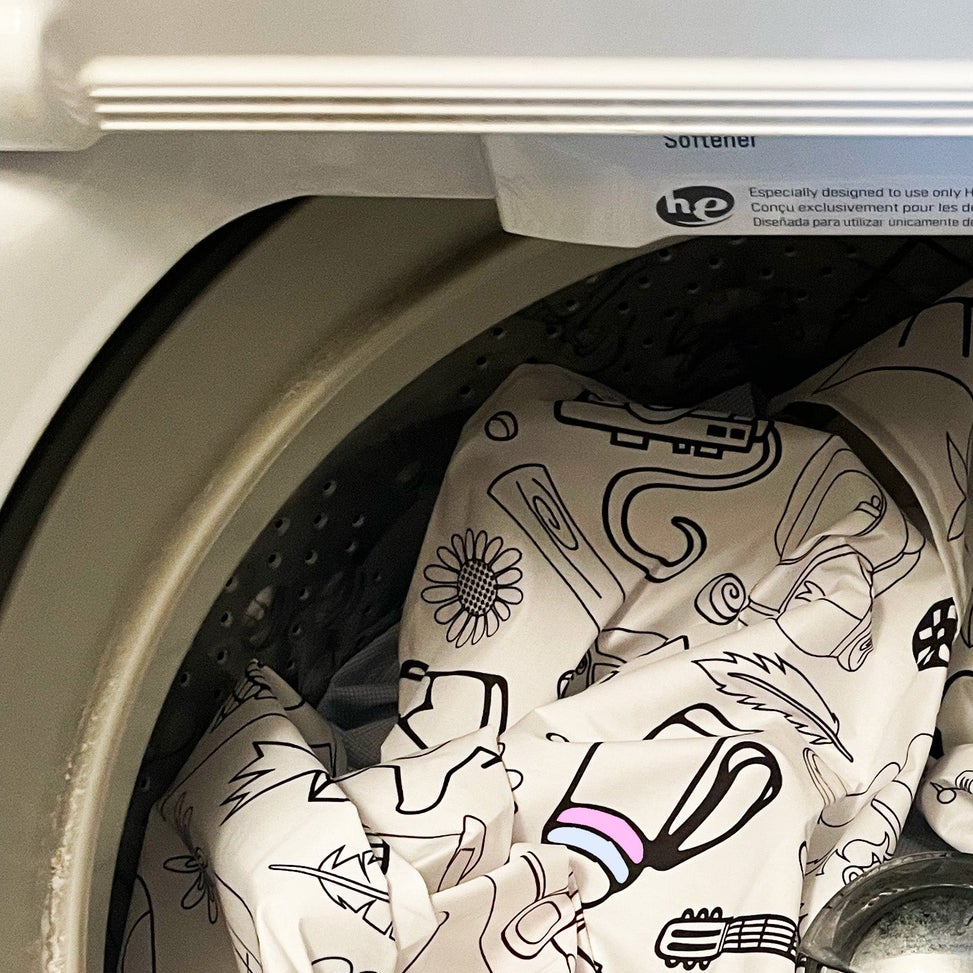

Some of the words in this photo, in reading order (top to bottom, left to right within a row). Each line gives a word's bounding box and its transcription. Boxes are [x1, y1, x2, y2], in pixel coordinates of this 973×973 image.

[749, 187, 817, 199] Especially
[822, 187, 884, 199] designed
[888, 187, 902, 198] to
[904, 189, 930, 198] use
[932, 187, 962, 199] only
[750, 202, 795, 214] Conçu
[798, 202, 899, 213] exclusivement
[902, 204, 935, 214] pour
[938, 202, 959, 213] les
[752, 217, 810, 228] Diseñada
[812, 219, 841, 229] para
[843, 217, 883, 228] utilizar
